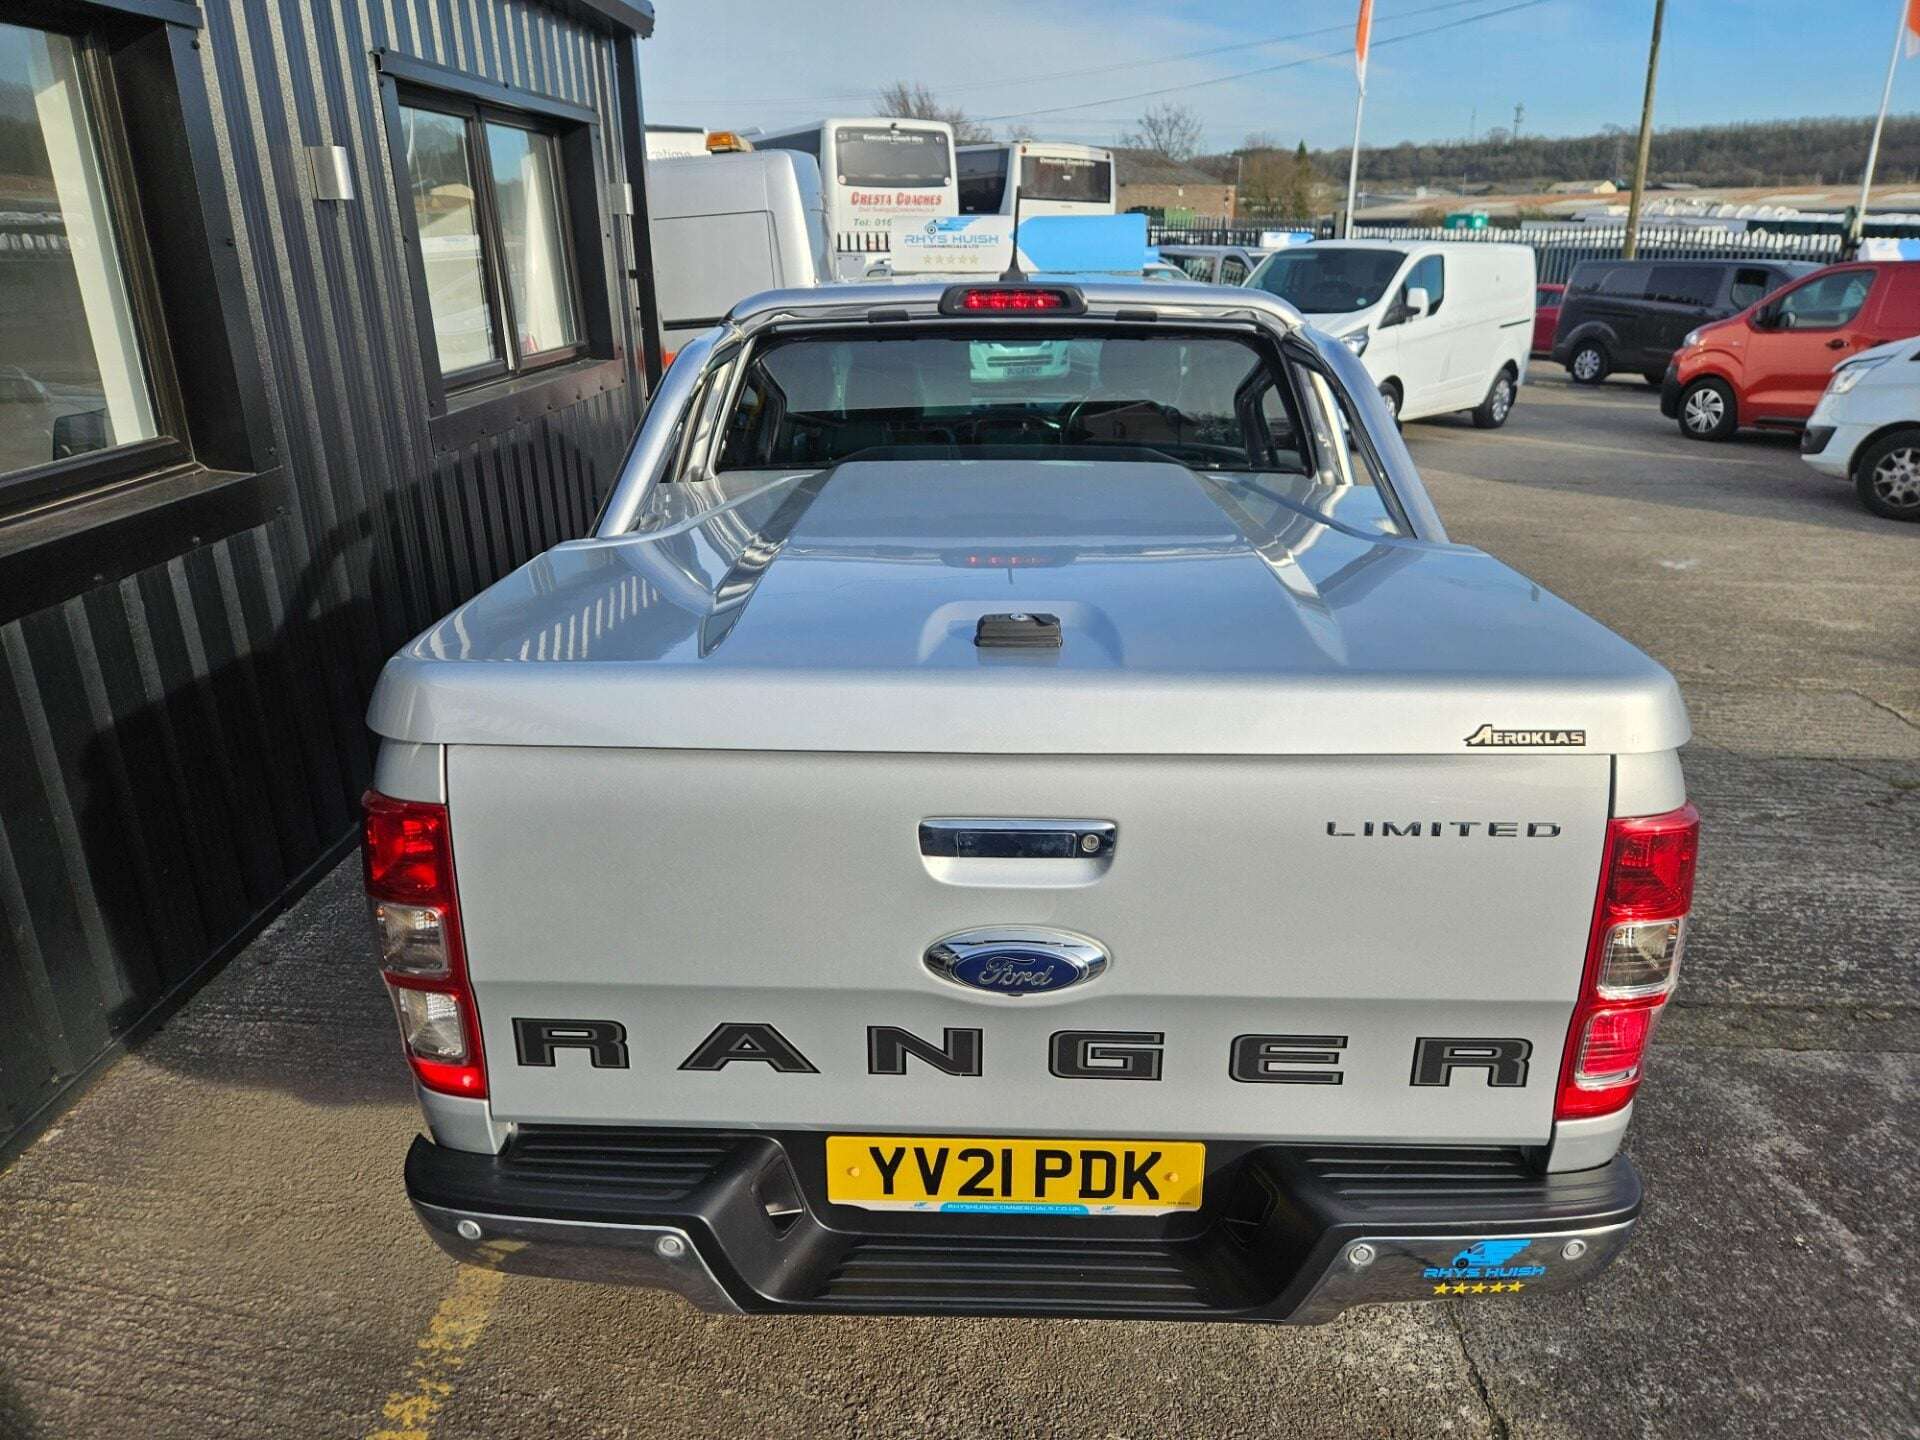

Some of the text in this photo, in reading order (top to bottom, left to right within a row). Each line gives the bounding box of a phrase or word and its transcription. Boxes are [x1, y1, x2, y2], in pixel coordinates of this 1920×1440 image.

[851, 191, 943, 206] CRESTA COACHES
[904, 234, 999, 244] RHYS HUISH
[1464, 724, 1585, 746] AEROKLAS
[1326, 820, 1561, 838] LIMITED
[979, 956, 1055, 986] Ford
[511, 1017, 1534, 1087] RANGER
[869, 1146, 1163, 1200] YV21 PDK
[1423, 1266, 1481, 1278] RHYS
[1485, 1265, 1546, 1278] HUISH
